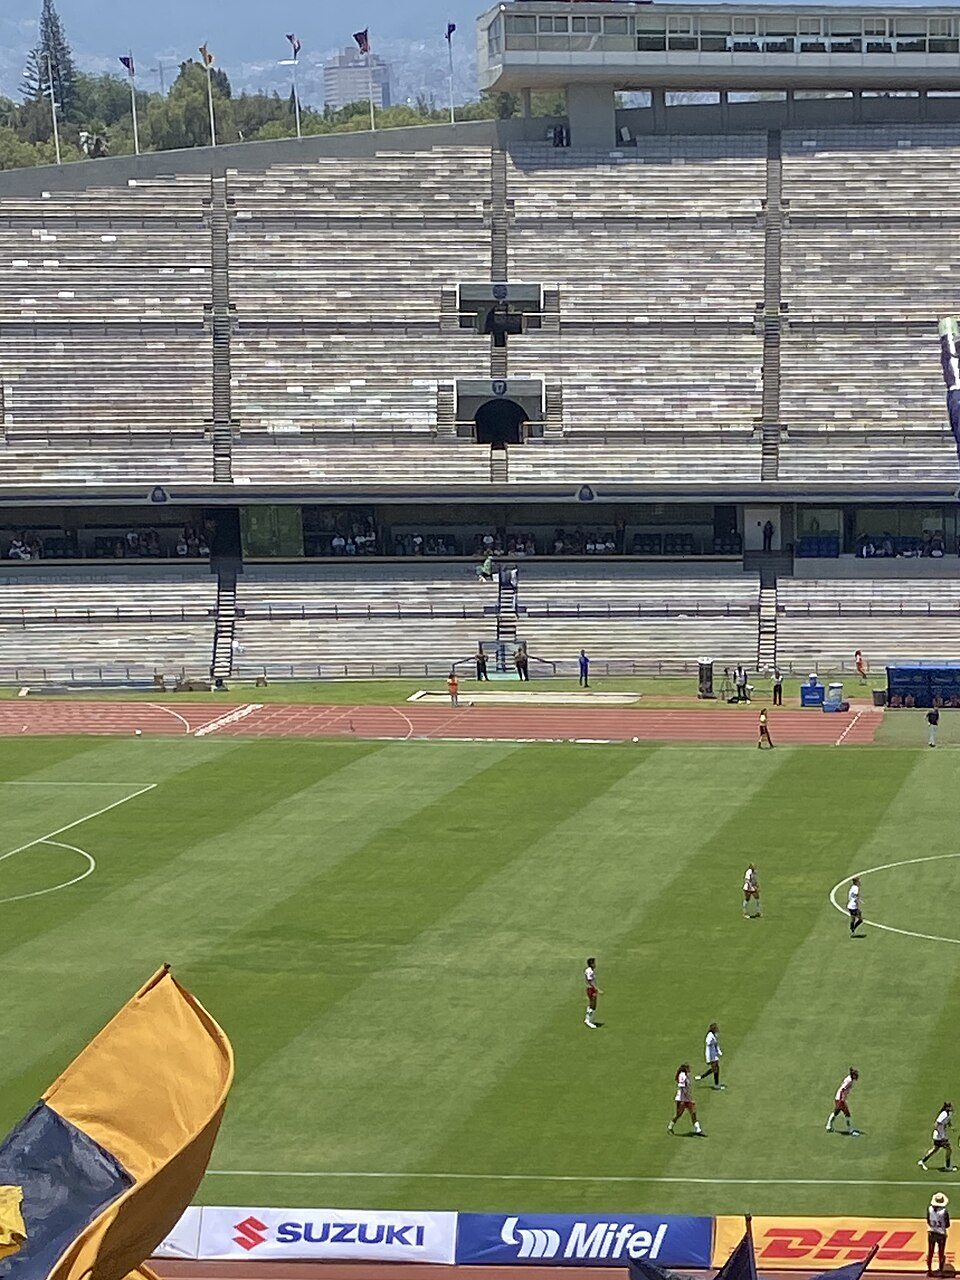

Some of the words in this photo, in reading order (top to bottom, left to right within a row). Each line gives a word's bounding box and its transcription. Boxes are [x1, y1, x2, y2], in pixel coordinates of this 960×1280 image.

[276, 1222, 425, 1246] SUZUKI
[563, 1222, 668, 1259] Mifel
[760, 1228, 926, 1260] DHL
